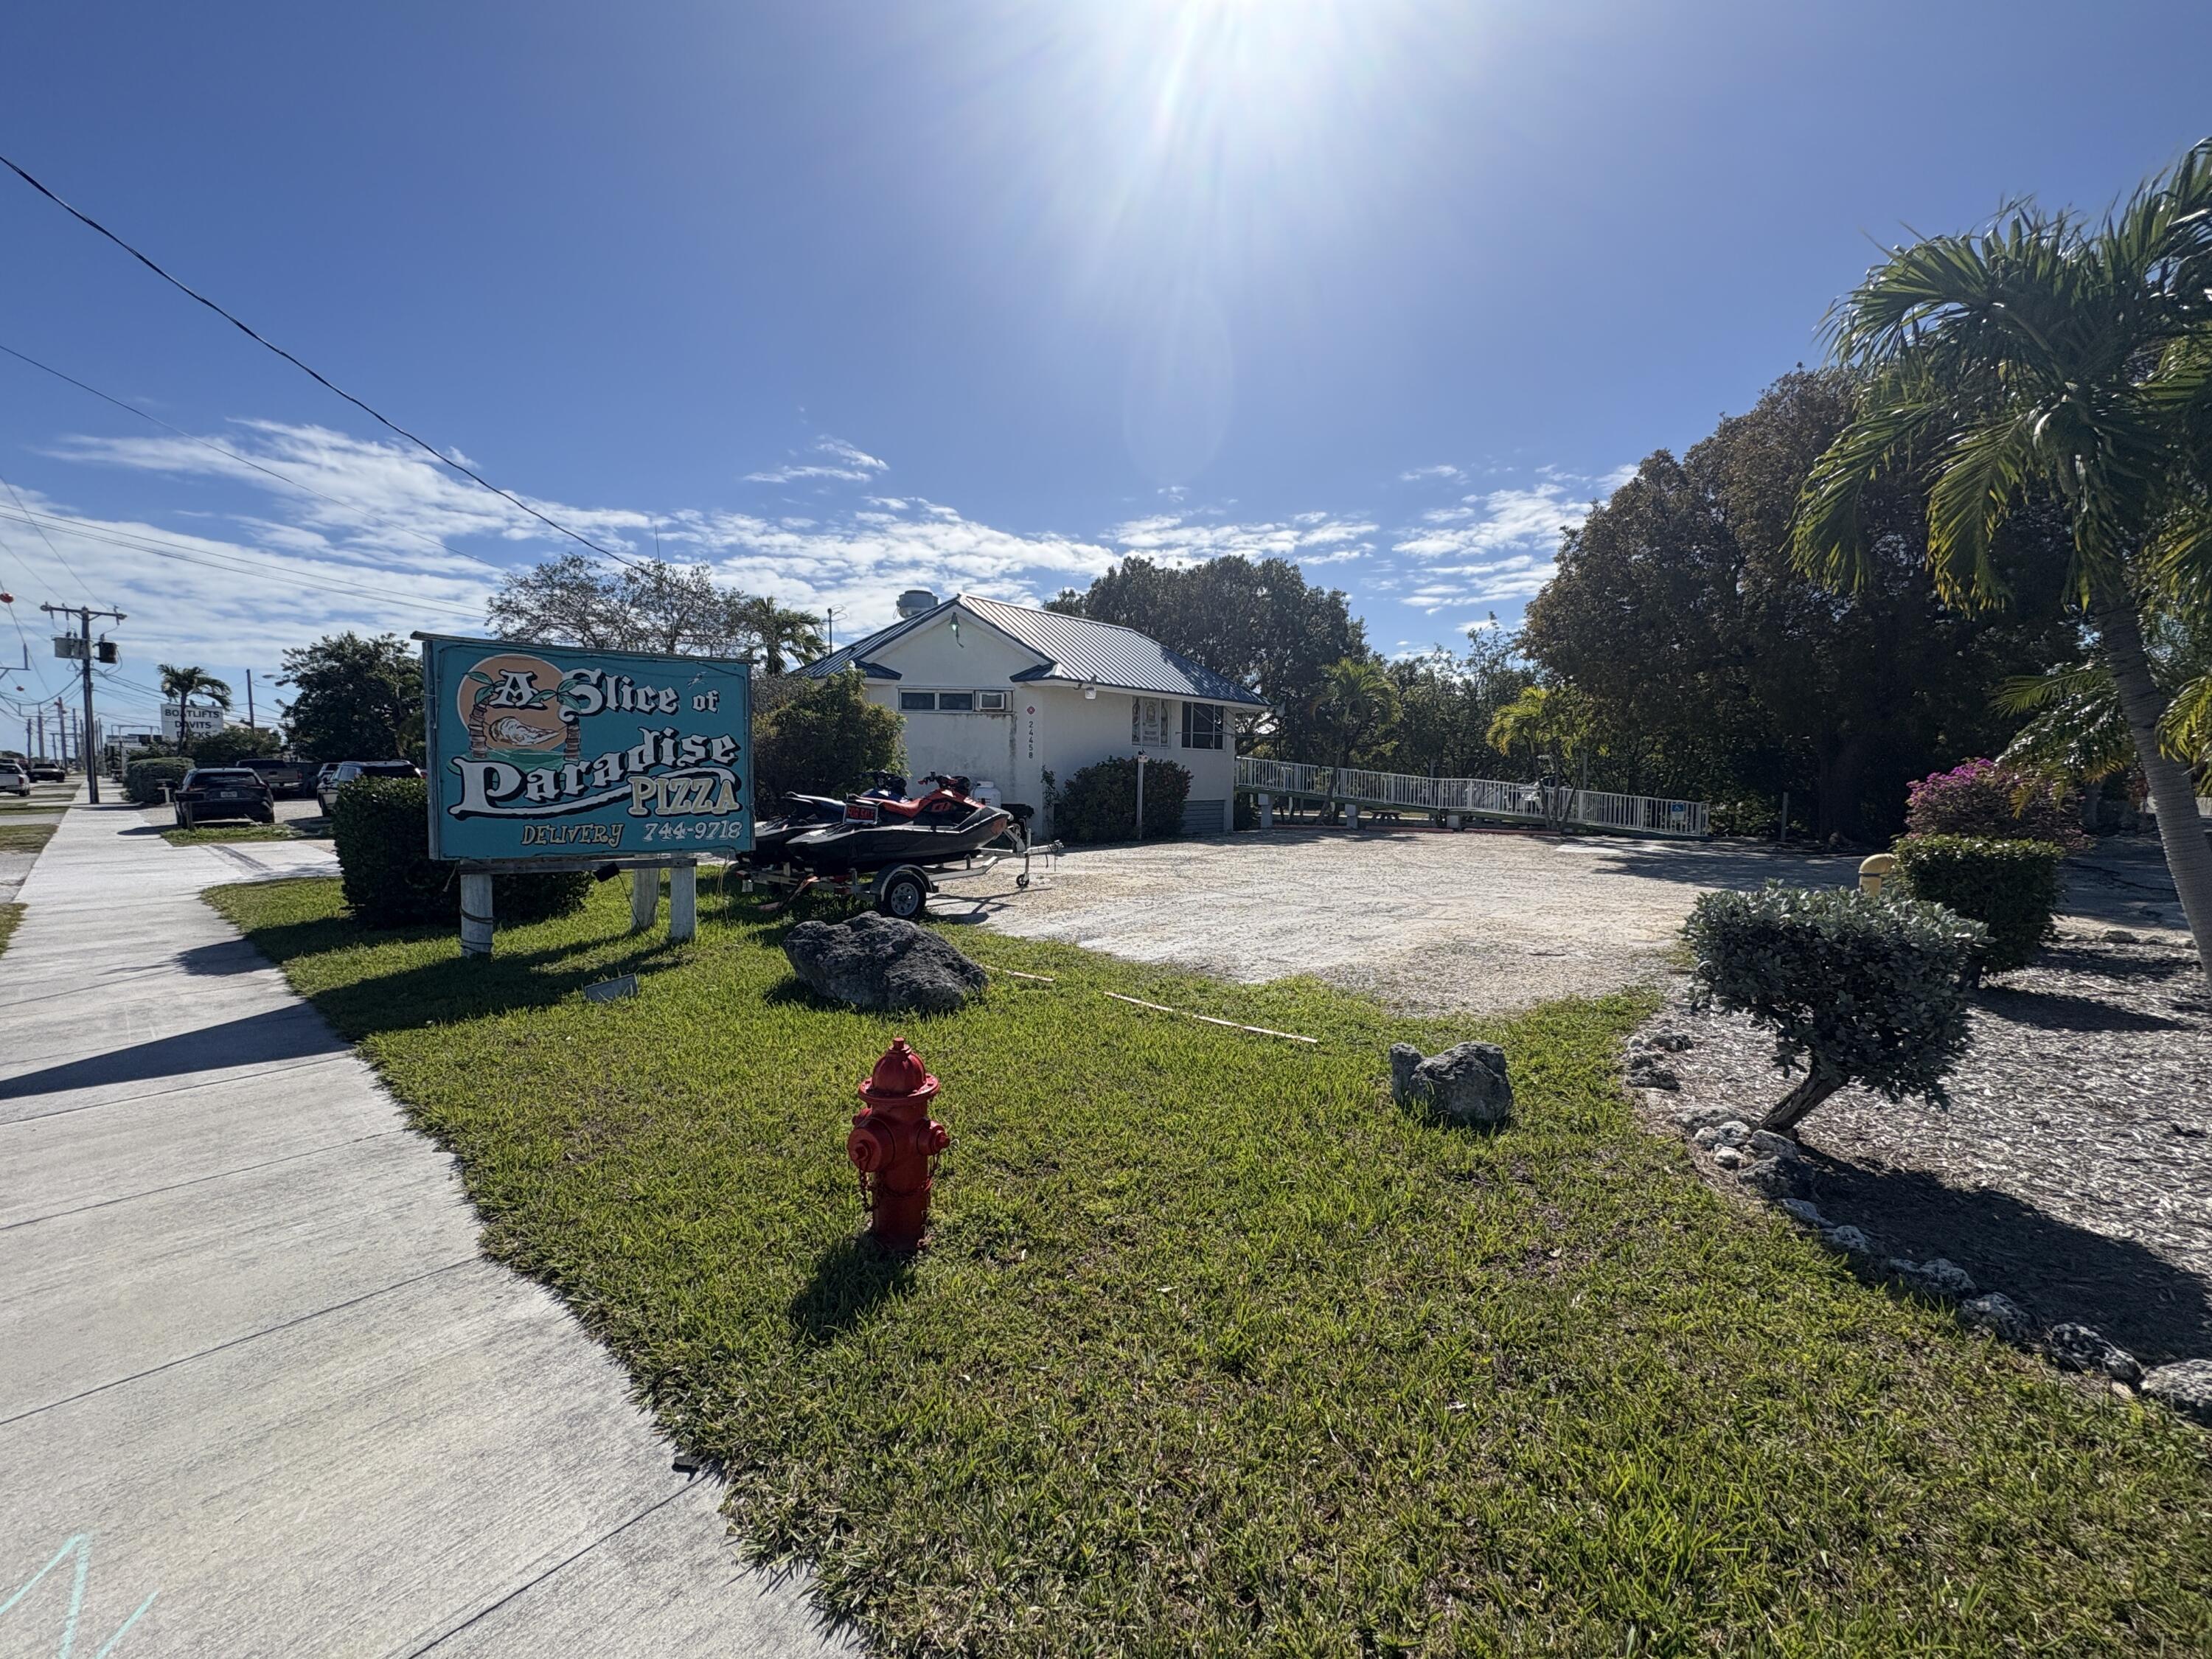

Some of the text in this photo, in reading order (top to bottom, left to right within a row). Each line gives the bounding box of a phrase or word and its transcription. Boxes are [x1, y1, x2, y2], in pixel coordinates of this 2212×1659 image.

[488, 667, 720, 723] A Slice of
[176, 731, 212, 740] DCKS
[449, 727, 737, 816] Paradise
[627, 776, 740, 815] PIZZA
[521, 820, 744, 847] DELIVERY 744-9718
